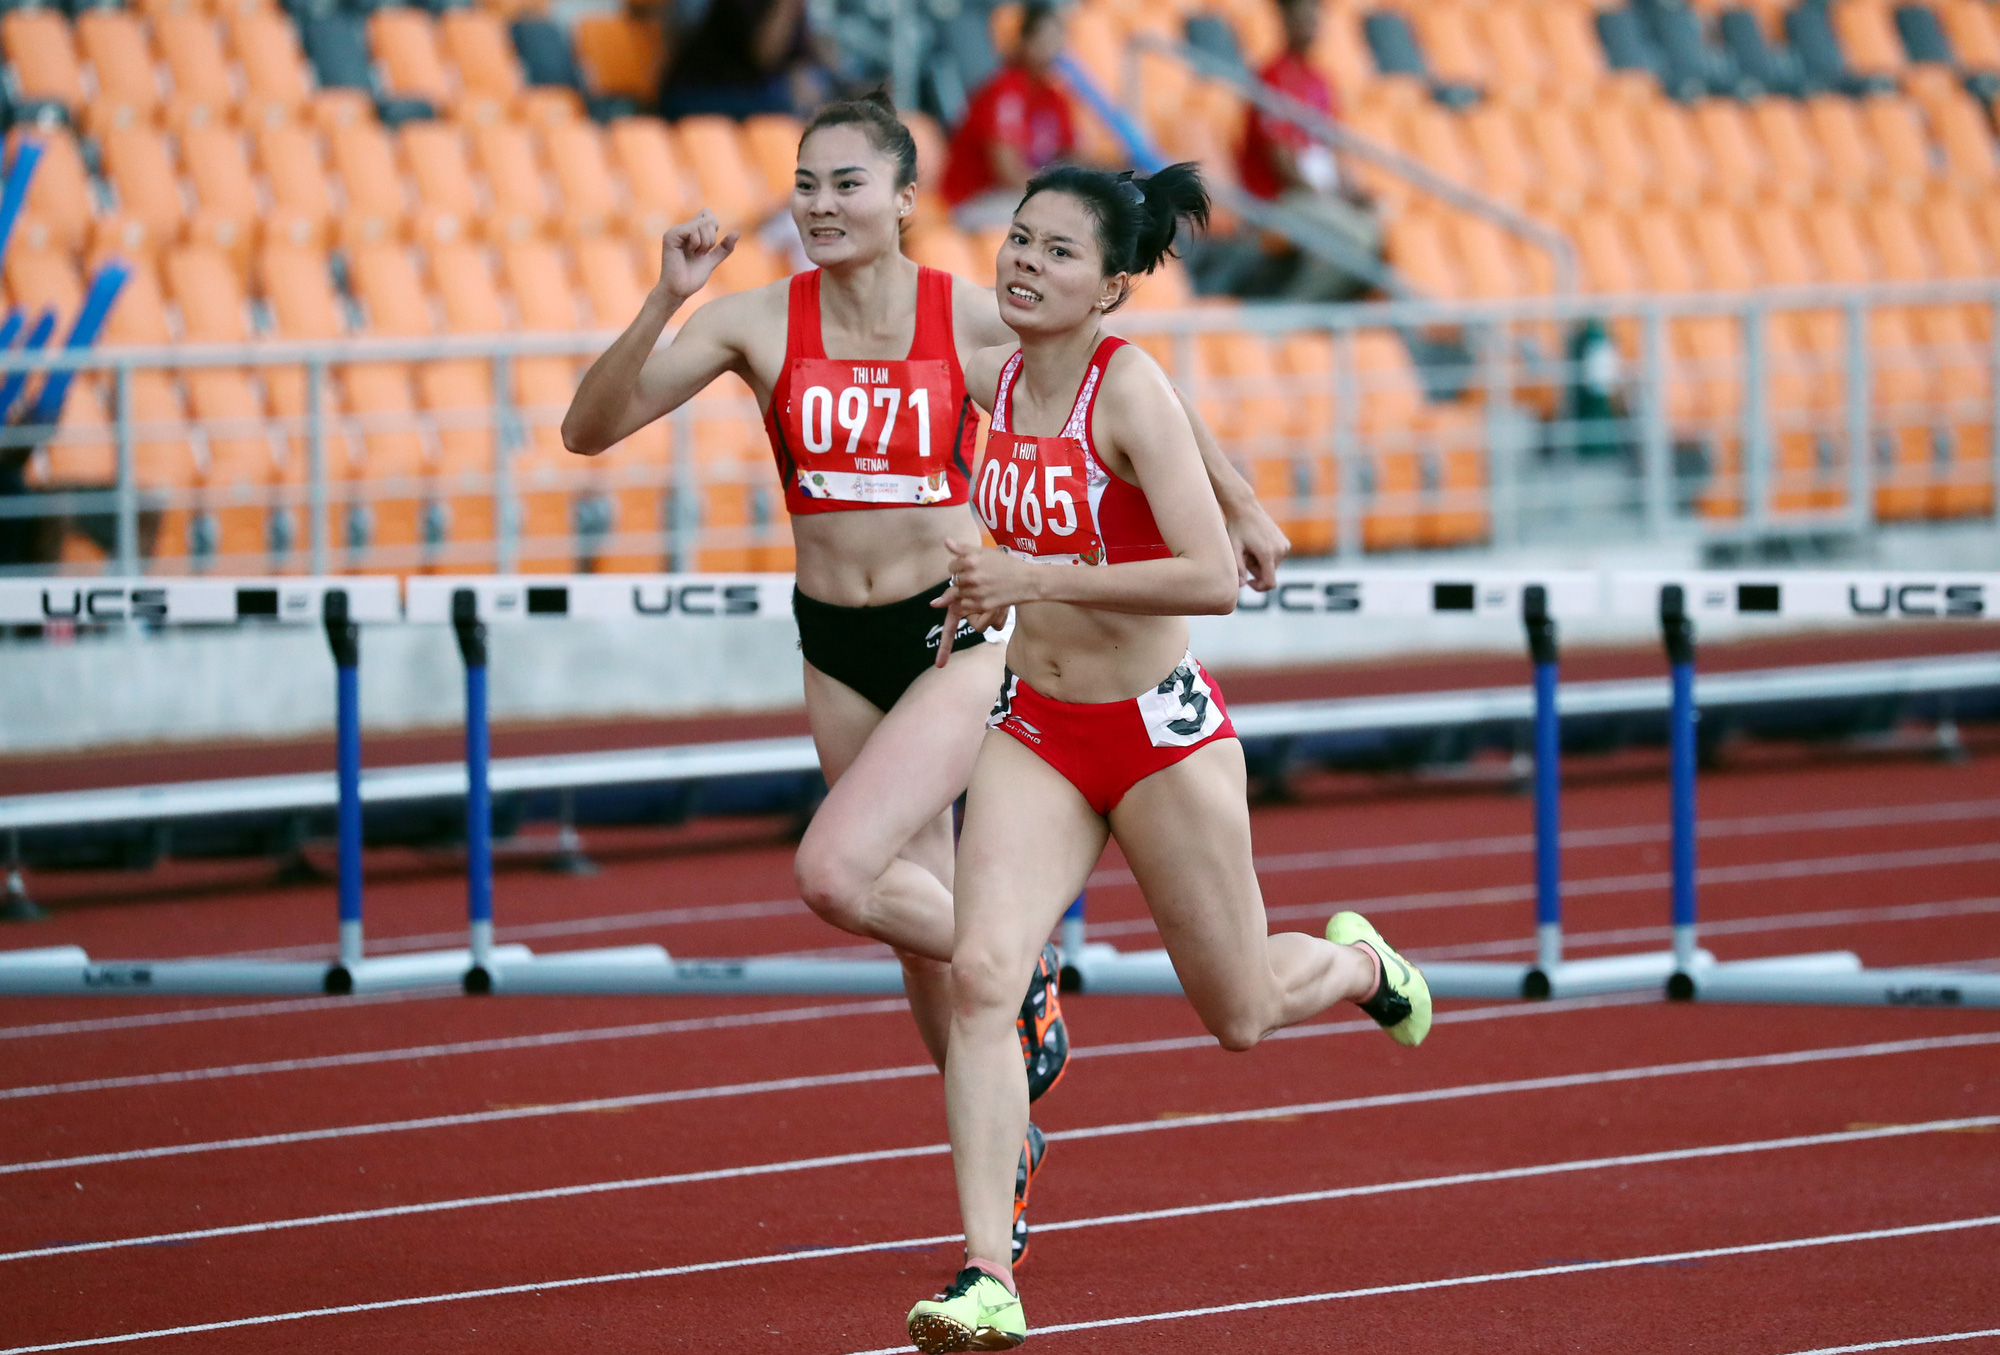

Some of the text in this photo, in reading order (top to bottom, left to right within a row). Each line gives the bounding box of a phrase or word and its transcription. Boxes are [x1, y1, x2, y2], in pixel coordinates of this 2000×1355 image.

[852, 367, 889, 385] THI LAN
[802, 385, 931, 457] 0971
[854, 457, 890, 472] VIETNAM
[978, 458, 1078, 537] 0965
[1014, 537, 1038, 554] VIETNA
[42, 588, 167, 619] UCS
[633, 584, 760, 615] UCS
[1236, 583, 1361, 612] UCS
[1849, 584, 1985, 615] UCS
[1157, 664, 1209, 736] 3
[1005, 721, 1042, 745] LI-NING
